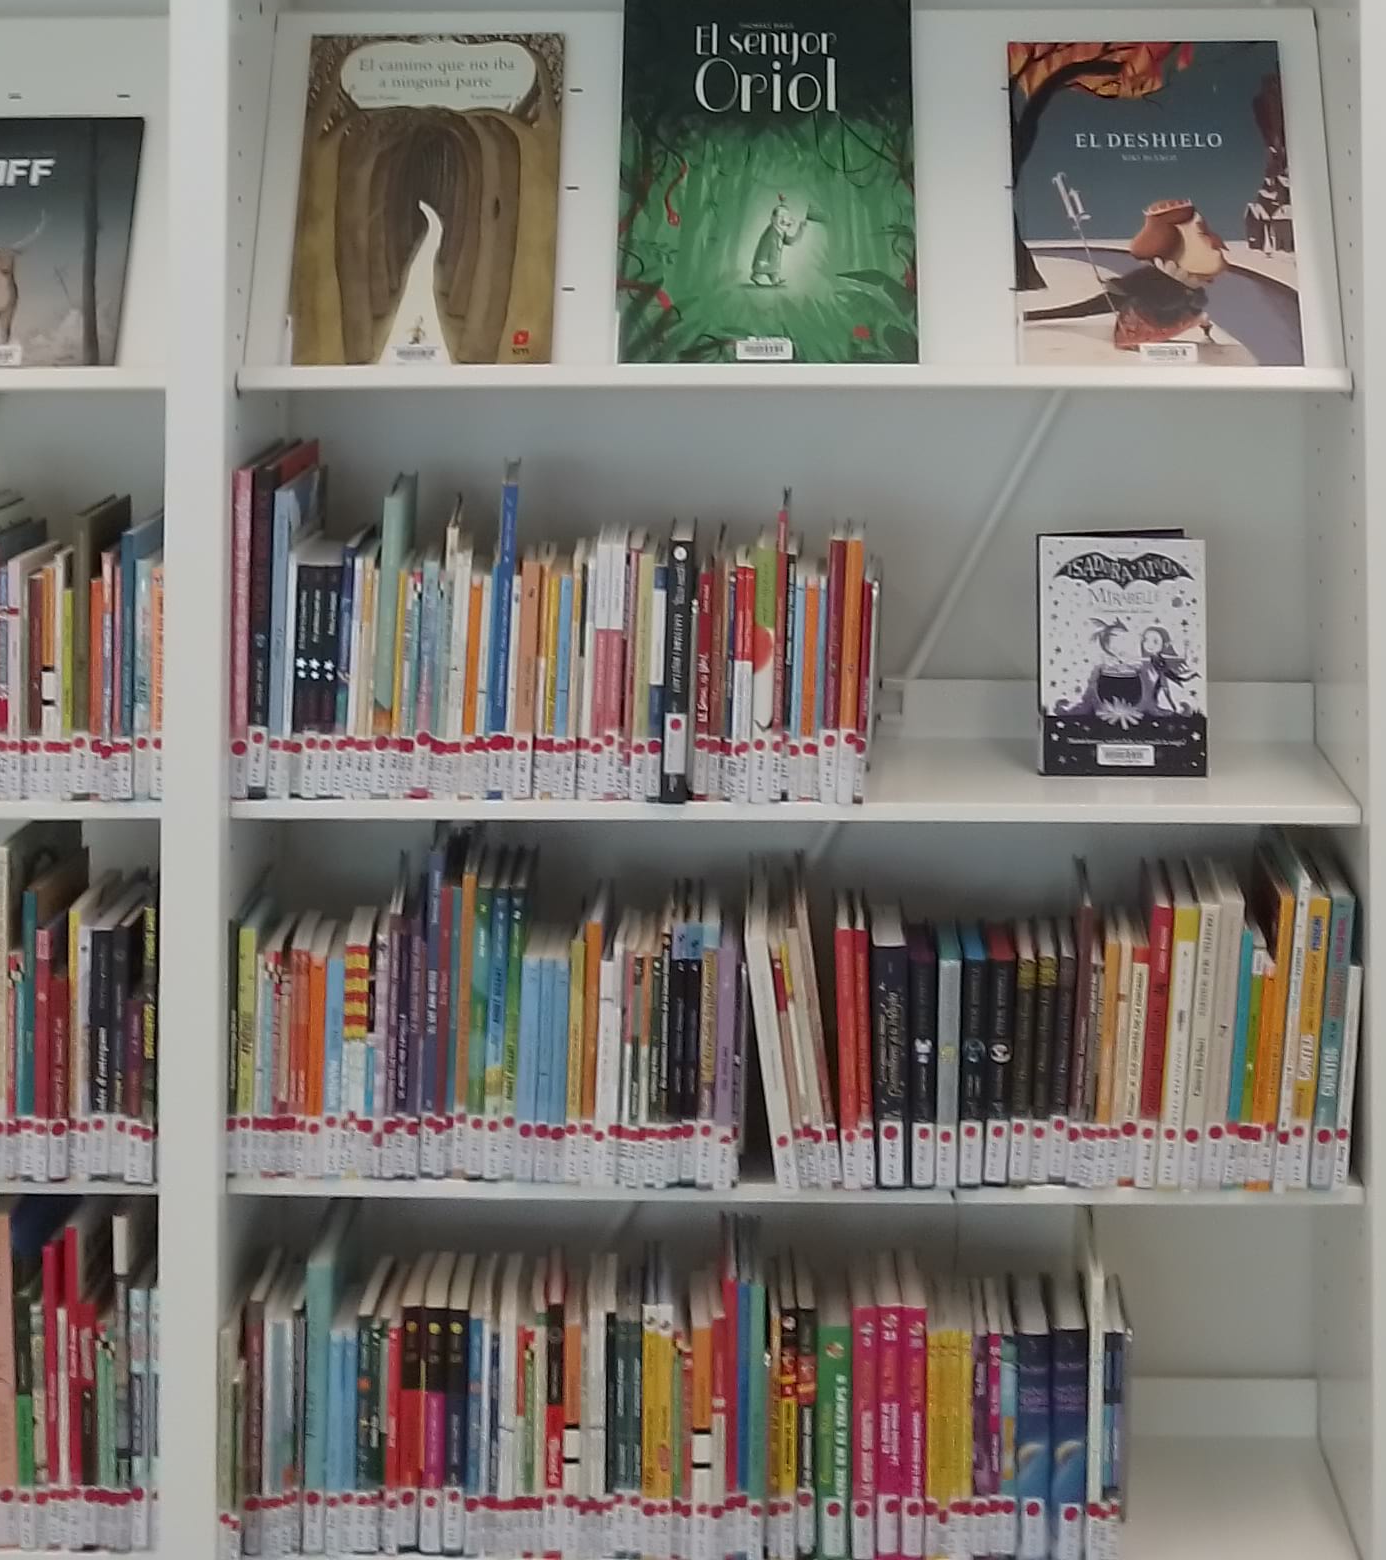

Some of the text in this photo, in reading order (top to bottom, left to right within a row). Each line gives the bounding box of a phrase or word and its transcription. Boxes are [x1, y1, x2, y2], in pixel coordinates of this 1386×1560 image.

[696, 22, 837, 66] El senyor
[359, 56, 516, 76] El camino que no iba
[379, 76, 492, 91] a ninguna parte
[695, 57, 836, 112] Oriol
[1075, 132, 1223, 148] EL DESHIELO
